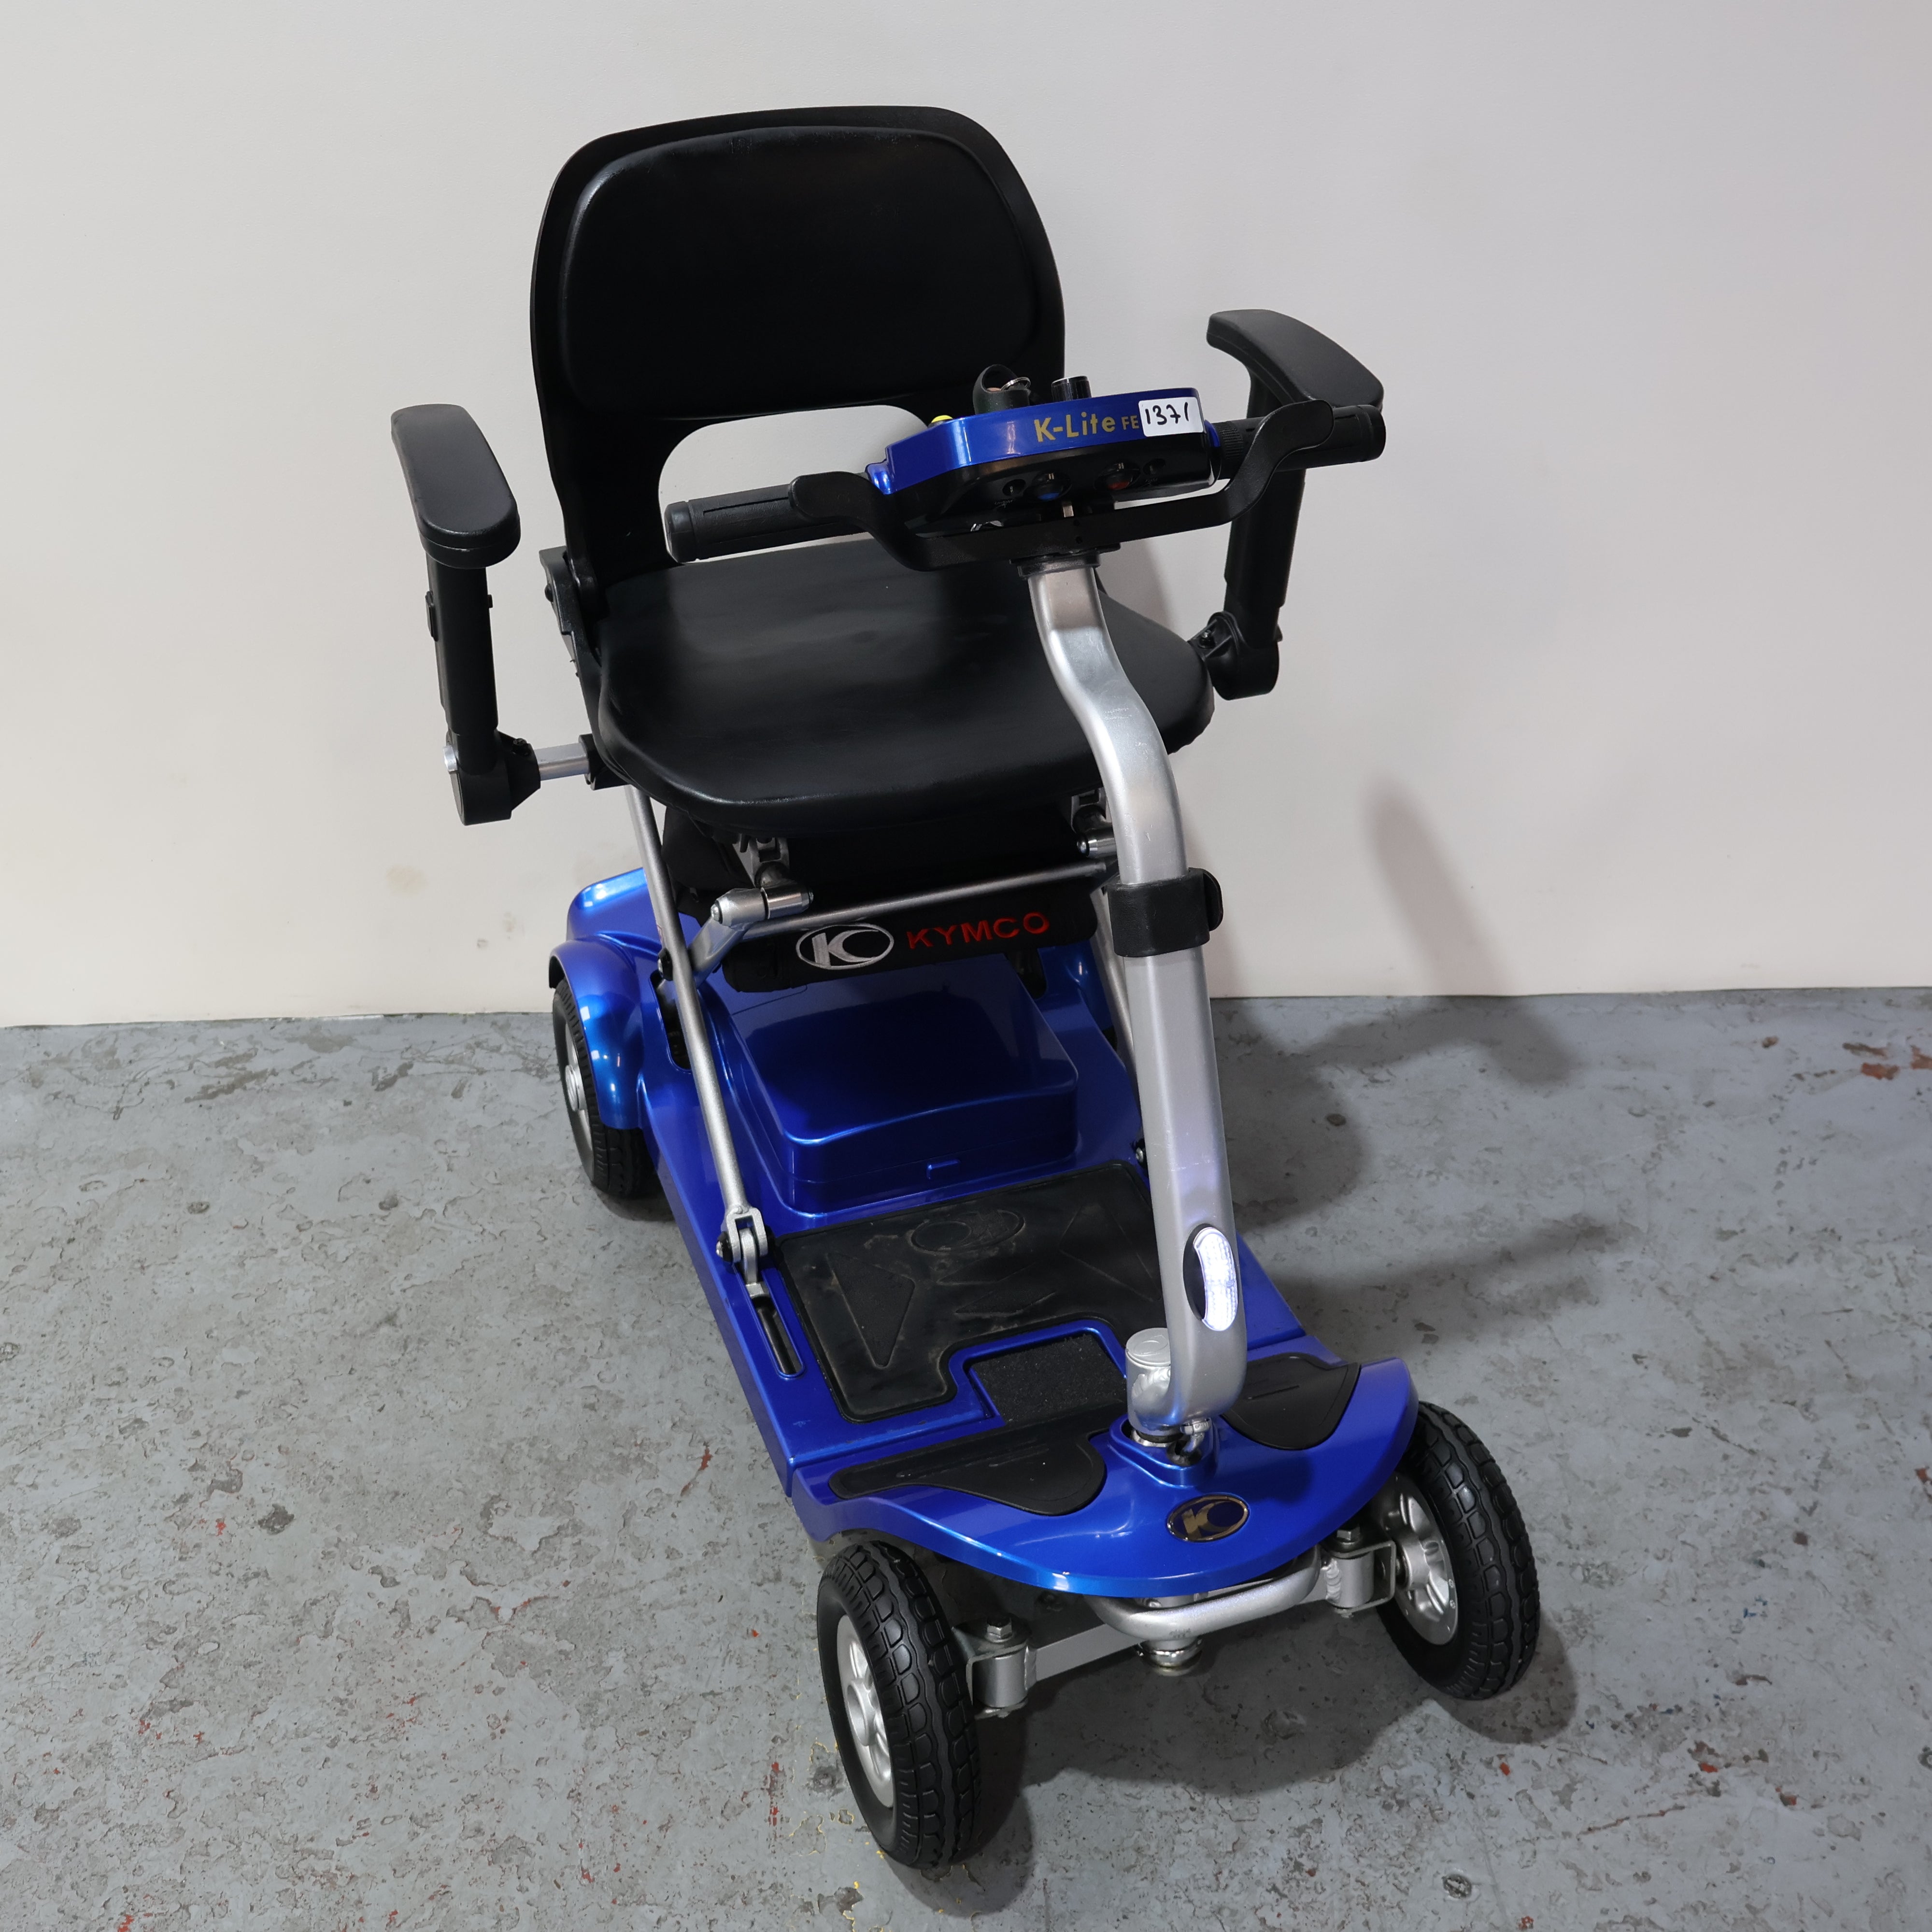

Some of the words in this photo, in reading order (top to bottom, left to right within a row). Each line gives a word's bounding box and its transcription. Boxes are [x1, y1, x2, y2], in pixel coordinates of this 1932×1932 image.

[1034, 412, 1116, 442] K-Lite
[1145, 401, 1189, 426] 1371
[906, 911, 1050, 949] KYMCO
